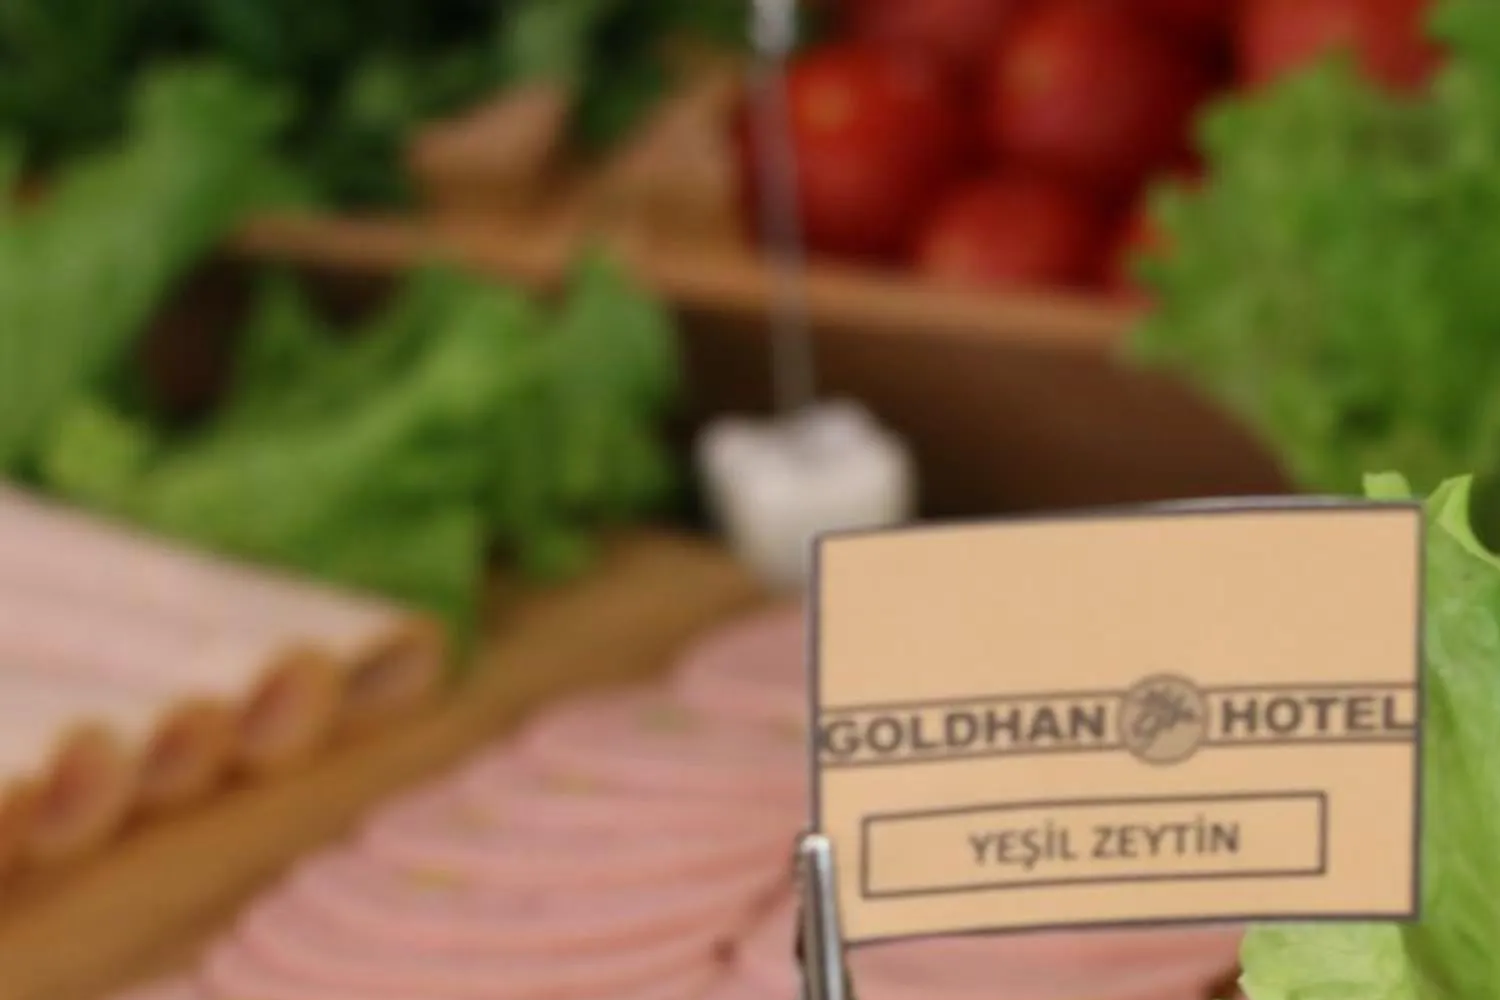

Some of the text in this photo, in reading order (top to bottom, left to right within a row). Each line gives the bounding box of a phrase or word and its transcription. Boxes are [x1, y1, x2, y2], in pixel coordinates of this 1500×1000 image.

[821, 694, 1416, 758] GOLDHAN HOTEL
[968, 814, 1240, 871] YEŞİL ZEYTİN
